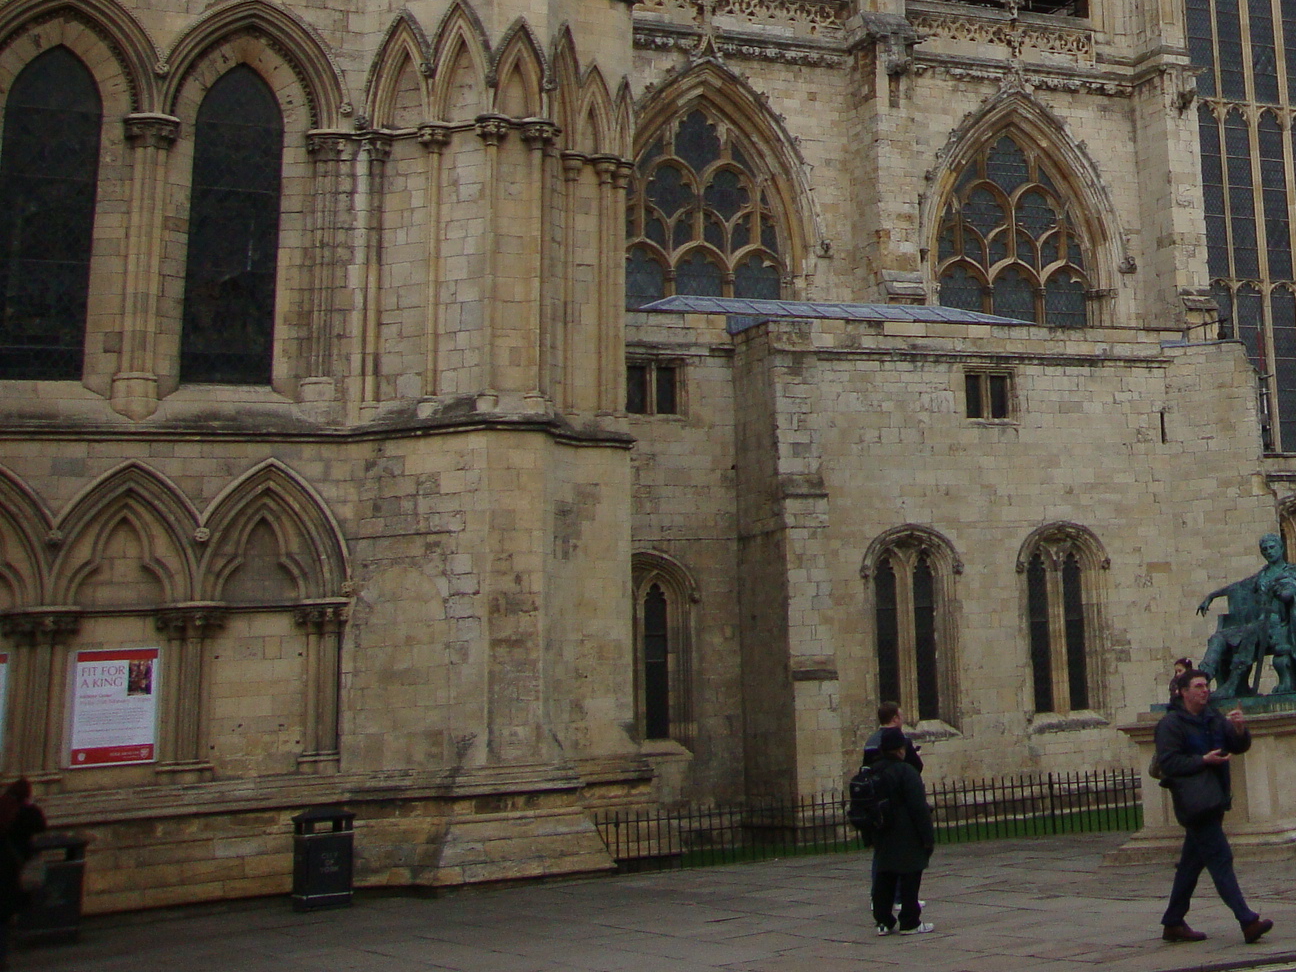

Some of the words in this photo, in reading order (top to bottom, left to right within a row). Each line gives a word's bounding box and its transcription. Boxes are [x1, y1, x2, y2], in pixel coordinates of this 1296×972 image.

[81, 666, 98, 677] FIT
[101, 665, 126, 676] FOR
[81, 679, 90, 688] A
[92, 676, 123, 688] KING
[321, 851, 339, 860] CITY
